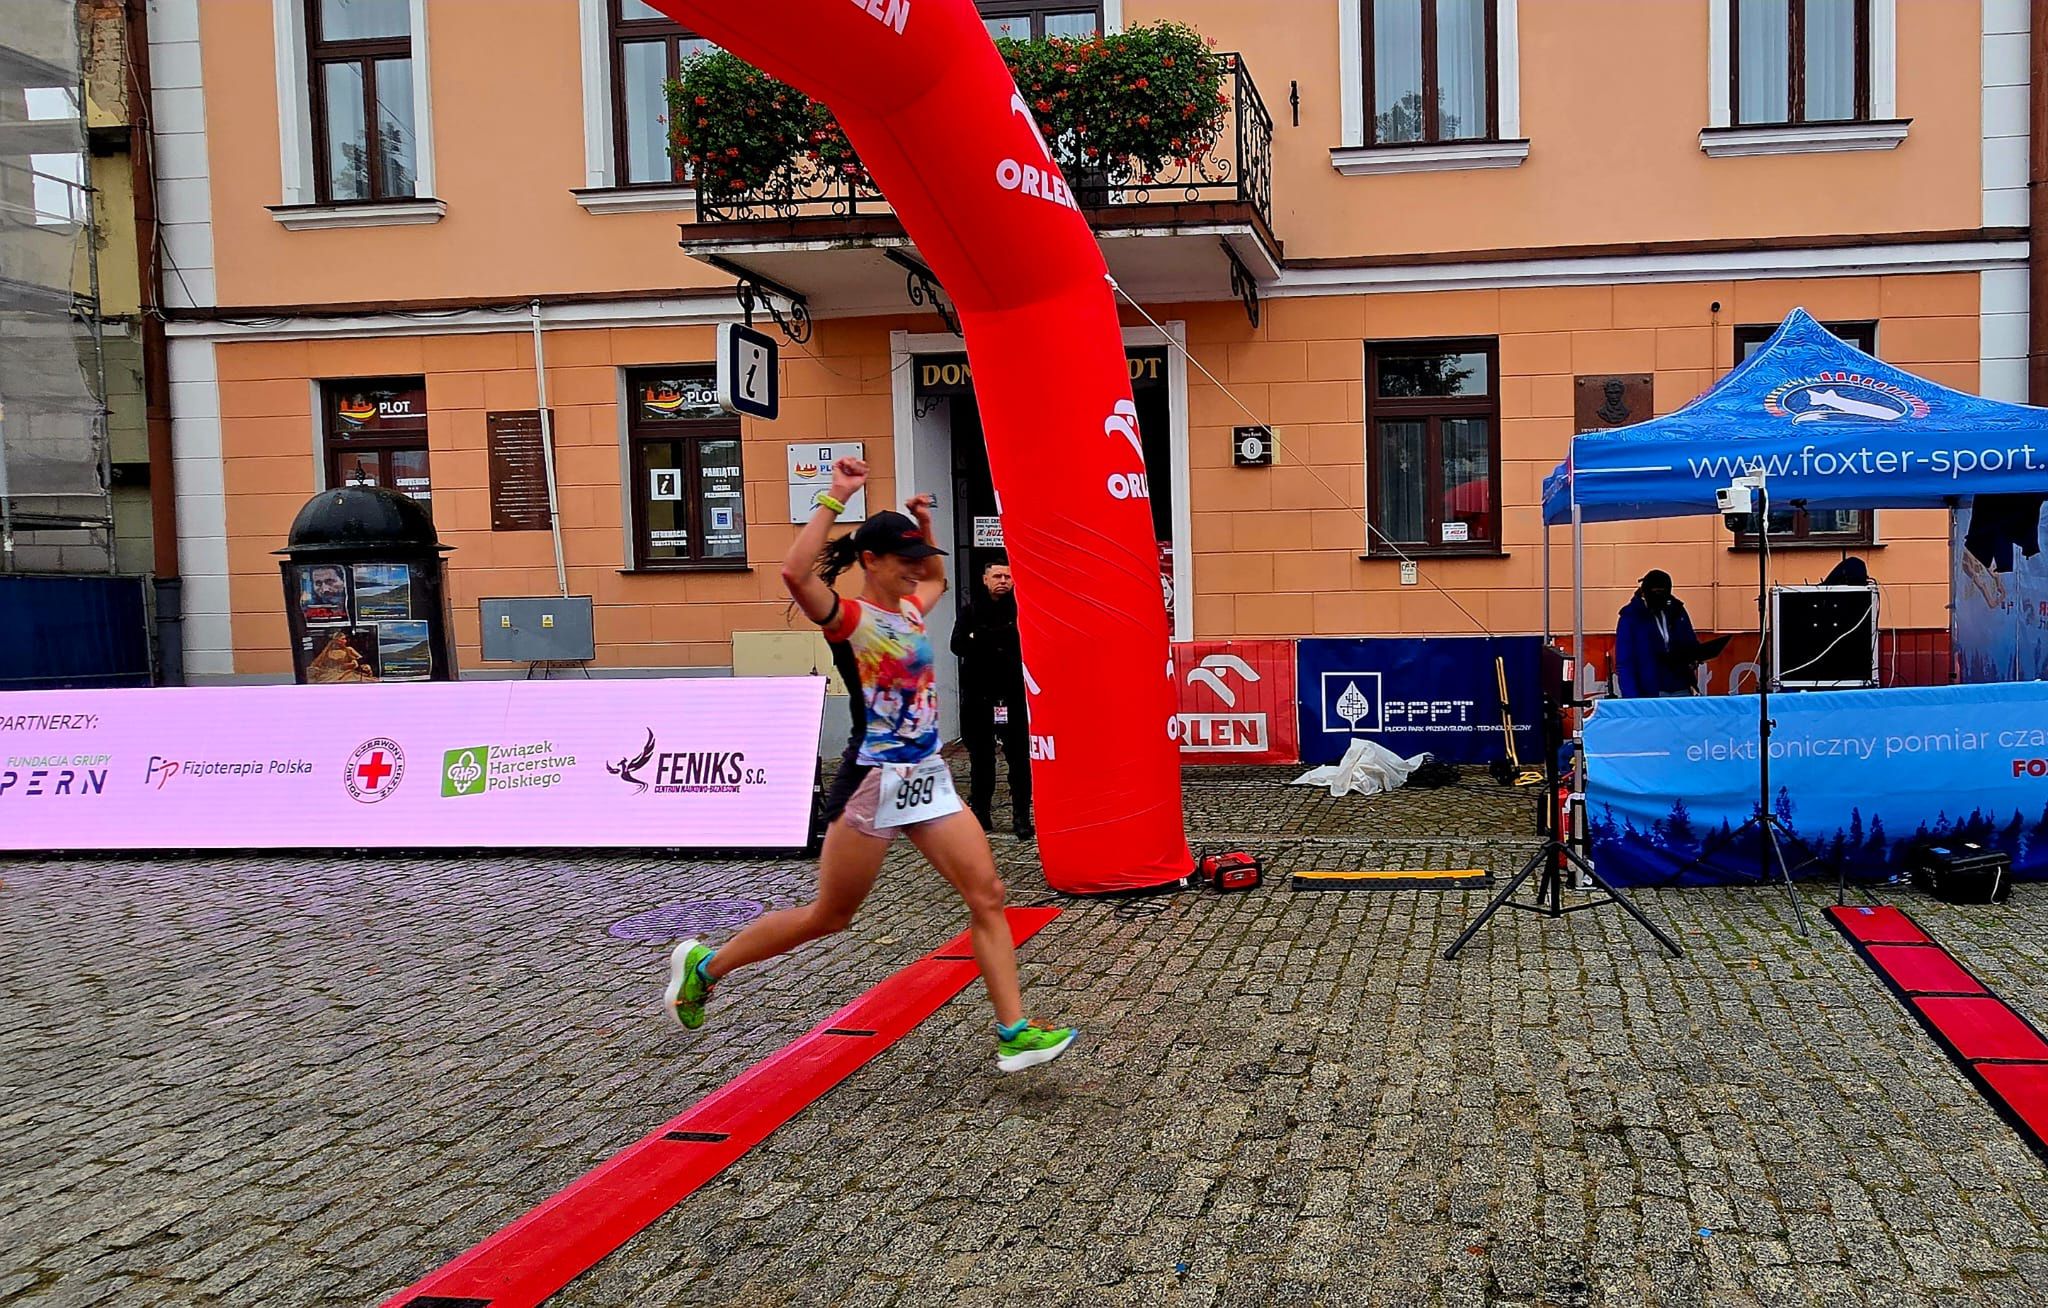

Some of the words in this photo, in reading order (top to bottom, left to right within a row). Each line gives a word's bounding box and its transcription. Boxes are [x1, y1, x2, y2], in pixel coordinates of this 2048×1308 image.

[379, 401, 410, 413] PLOT
[1249, 442, 1255, 455] 8
[820, 464, 833, 472] PL
[1107, 473, 1149, 499] ORL
[1384, 701, 1473, 722] PPPT
[1178, 719, 1258, 746] RLEN
[355, 740, 403, 760] CZERWONY
[490, 741, 552, 759] Związek
[1687, 735, 1877, 762] elektoniczny
[1886, 728, 1989, 758] pomiar
[1998, 729, 2048, 748] cza
[7, 756, 69, 767] FUNDACJA
[72, 755, 112, 766] GRUPY
[182, 760, 263, 777] Fizjoterapia
[269, 759, 312, 774] Polska
[490, 755, 576, 775] Harcerstwa
[656, 752, 744, 784] FENIKS
[2012, 759, 2048, 778] FO
[0, 770, 108, 795] PERN
[489, 773, 561, 791] Polskiego
[896, 776, 935, 809] 989
